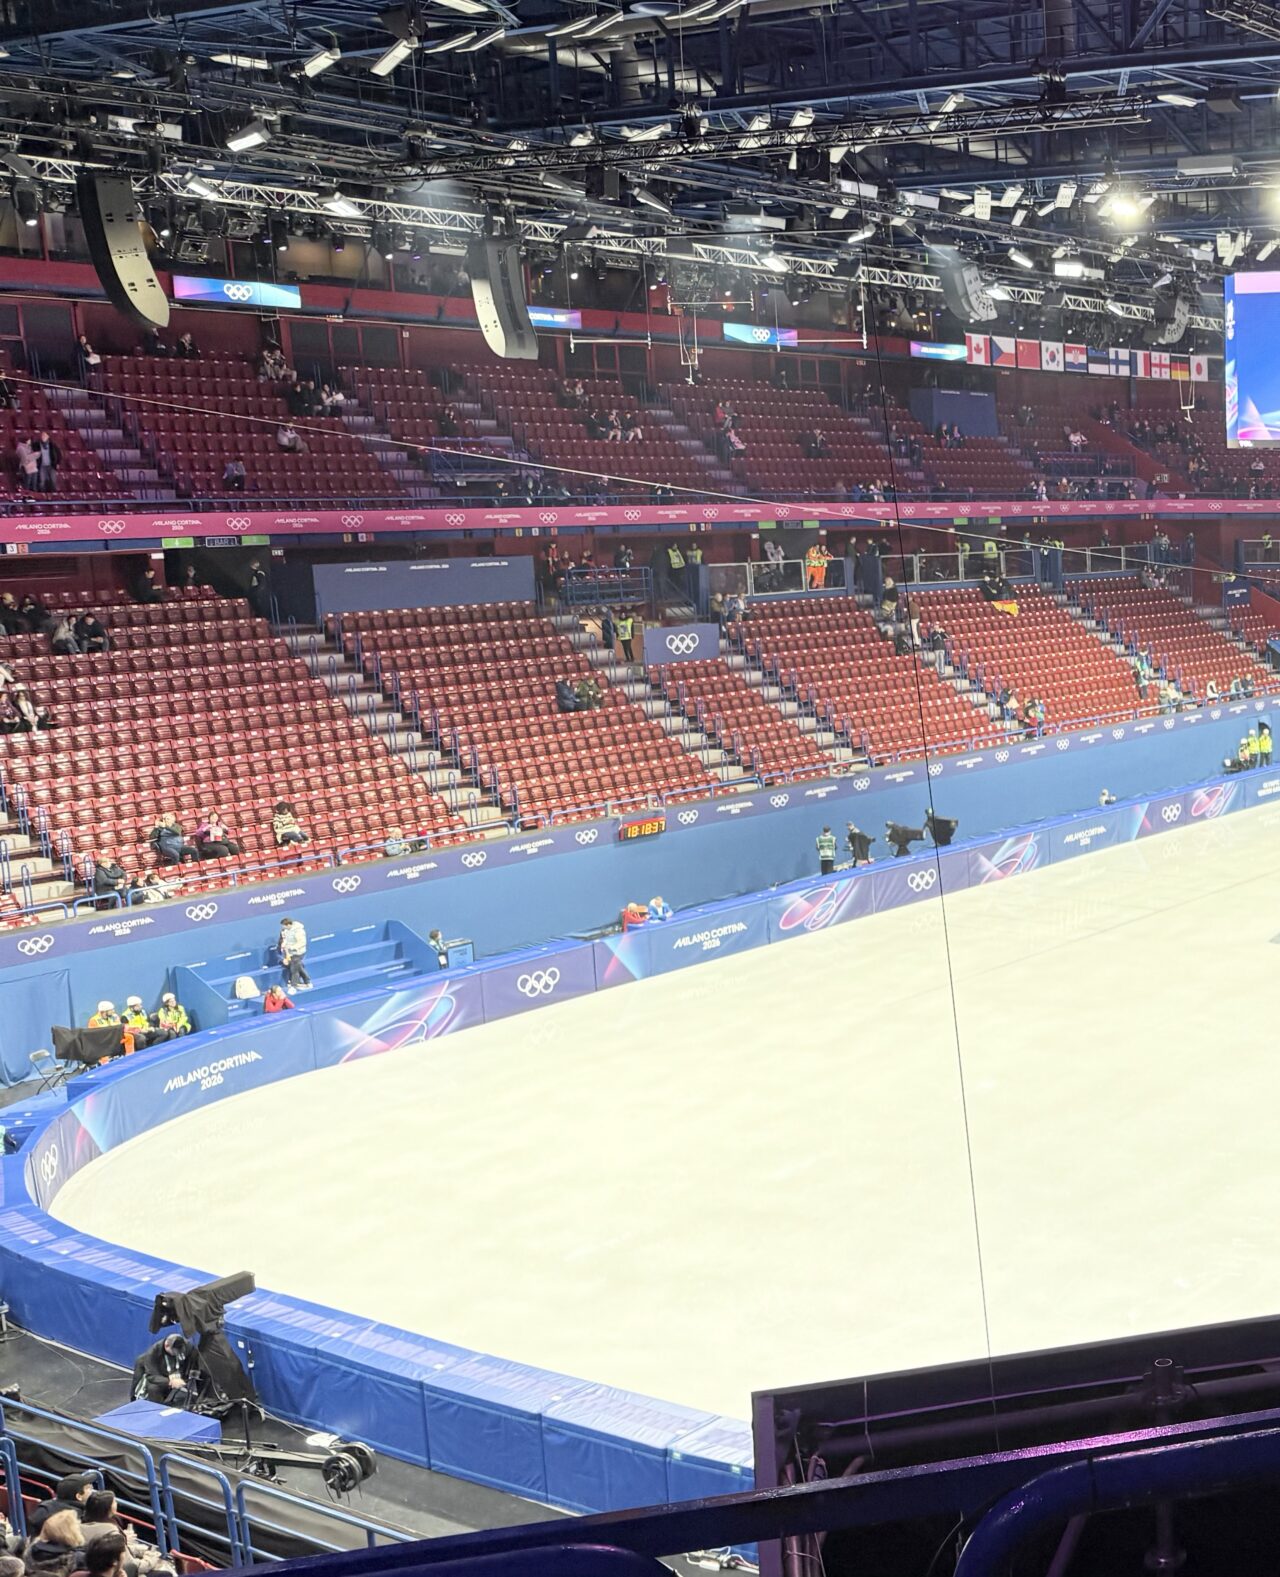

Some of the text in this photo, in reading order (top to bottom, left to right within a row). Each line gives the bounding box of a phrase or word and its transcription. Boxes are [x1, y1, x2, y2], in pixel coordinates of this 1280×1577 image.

[88, 917, 155, 935] MILANO CORTINA
[673, 921, 748, 950] MILANO CORTINA
[163, 1050, 263, 1094] MILANO CORTINA
[200, 1072, 224, 1091] 2026
